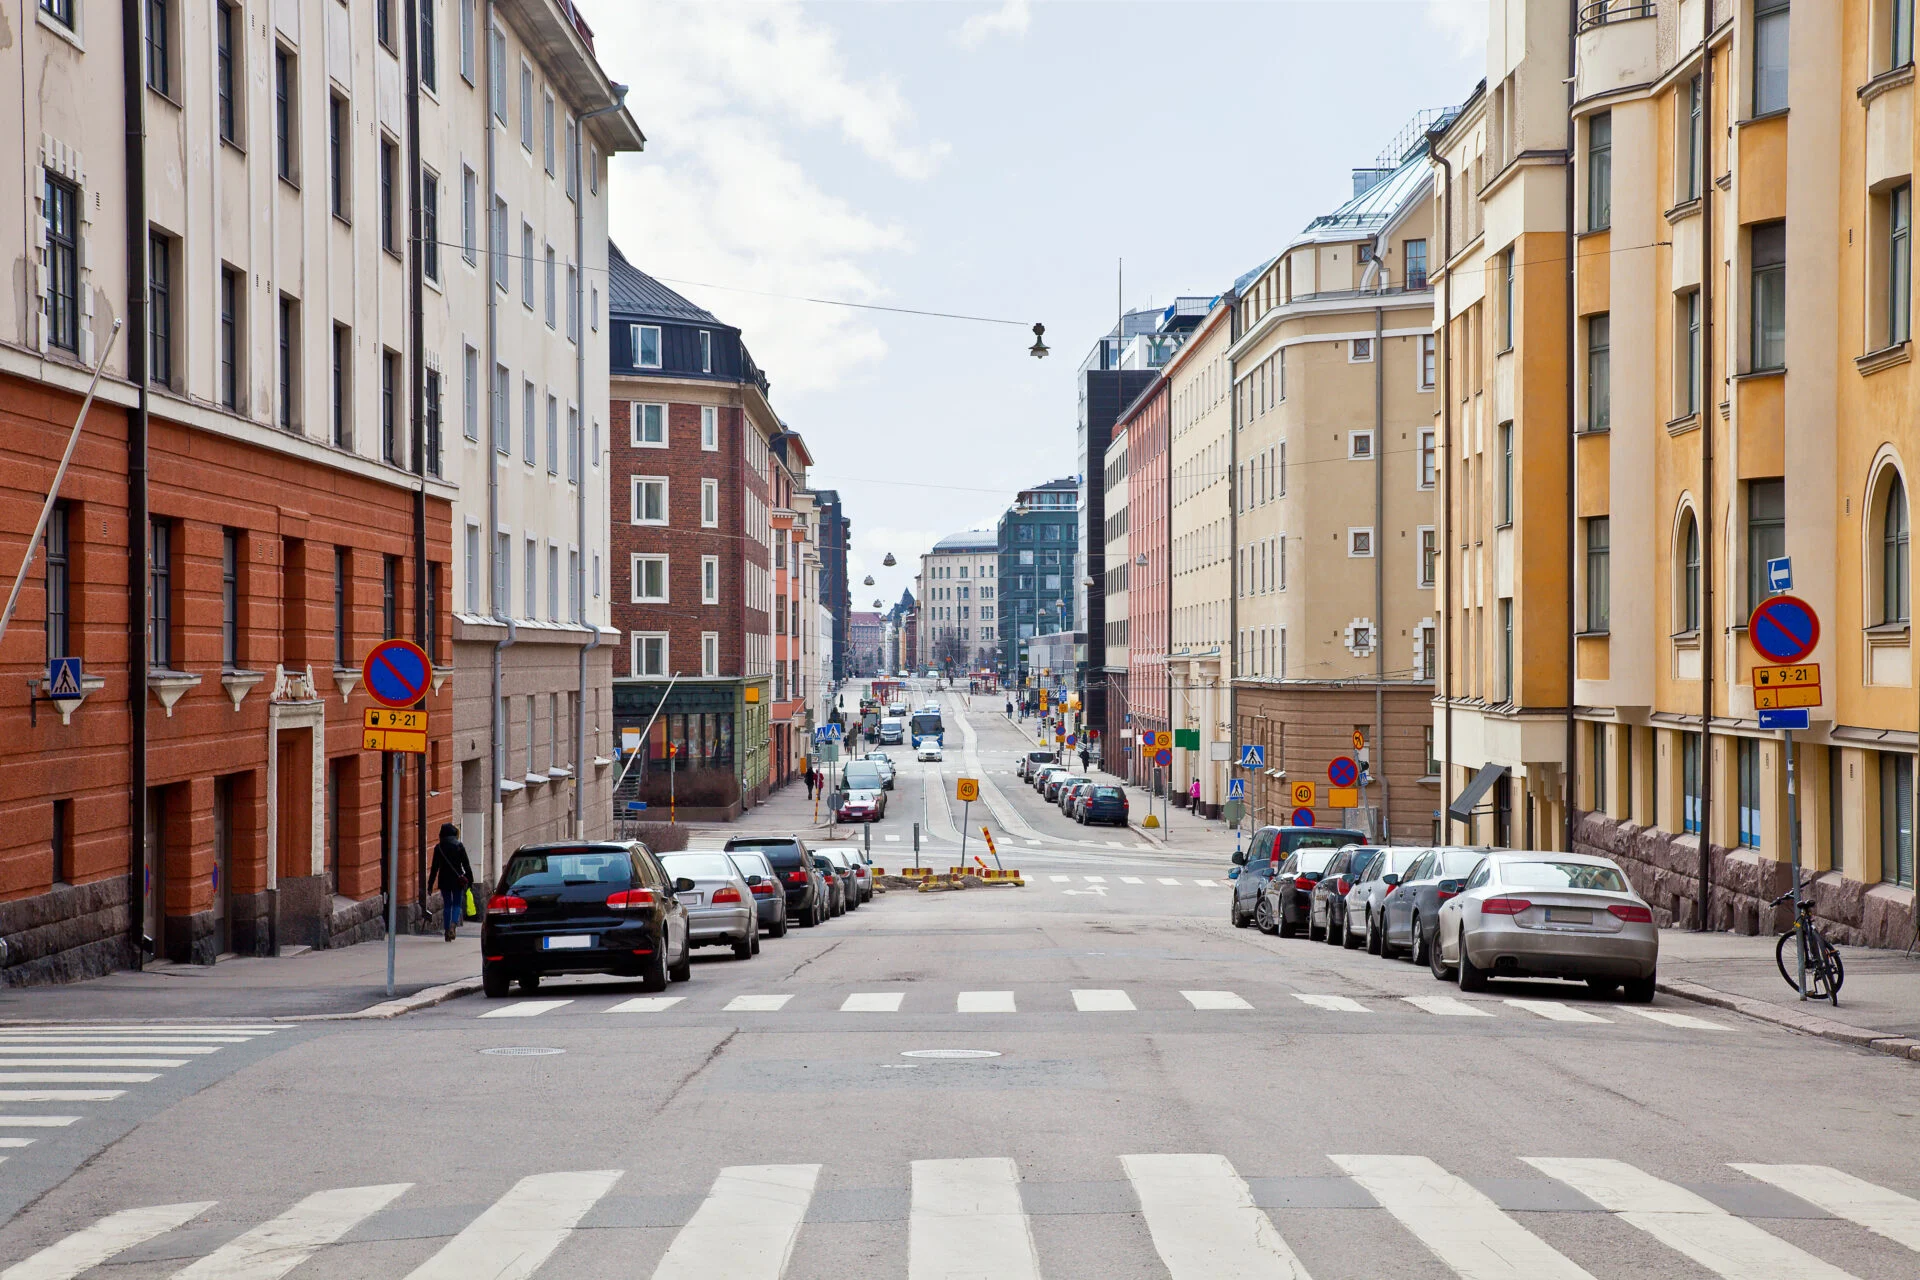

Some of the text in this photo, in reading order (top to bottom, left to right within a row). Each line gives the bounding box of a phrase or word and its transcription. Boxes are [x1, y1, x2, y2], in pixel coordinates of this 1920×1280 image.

[1763, 697, 1769, 706] 2
[371, 738, 377, 748] 2
[963, 785, 972, 793] 40
[1298, 789, 1309, 799] 40
